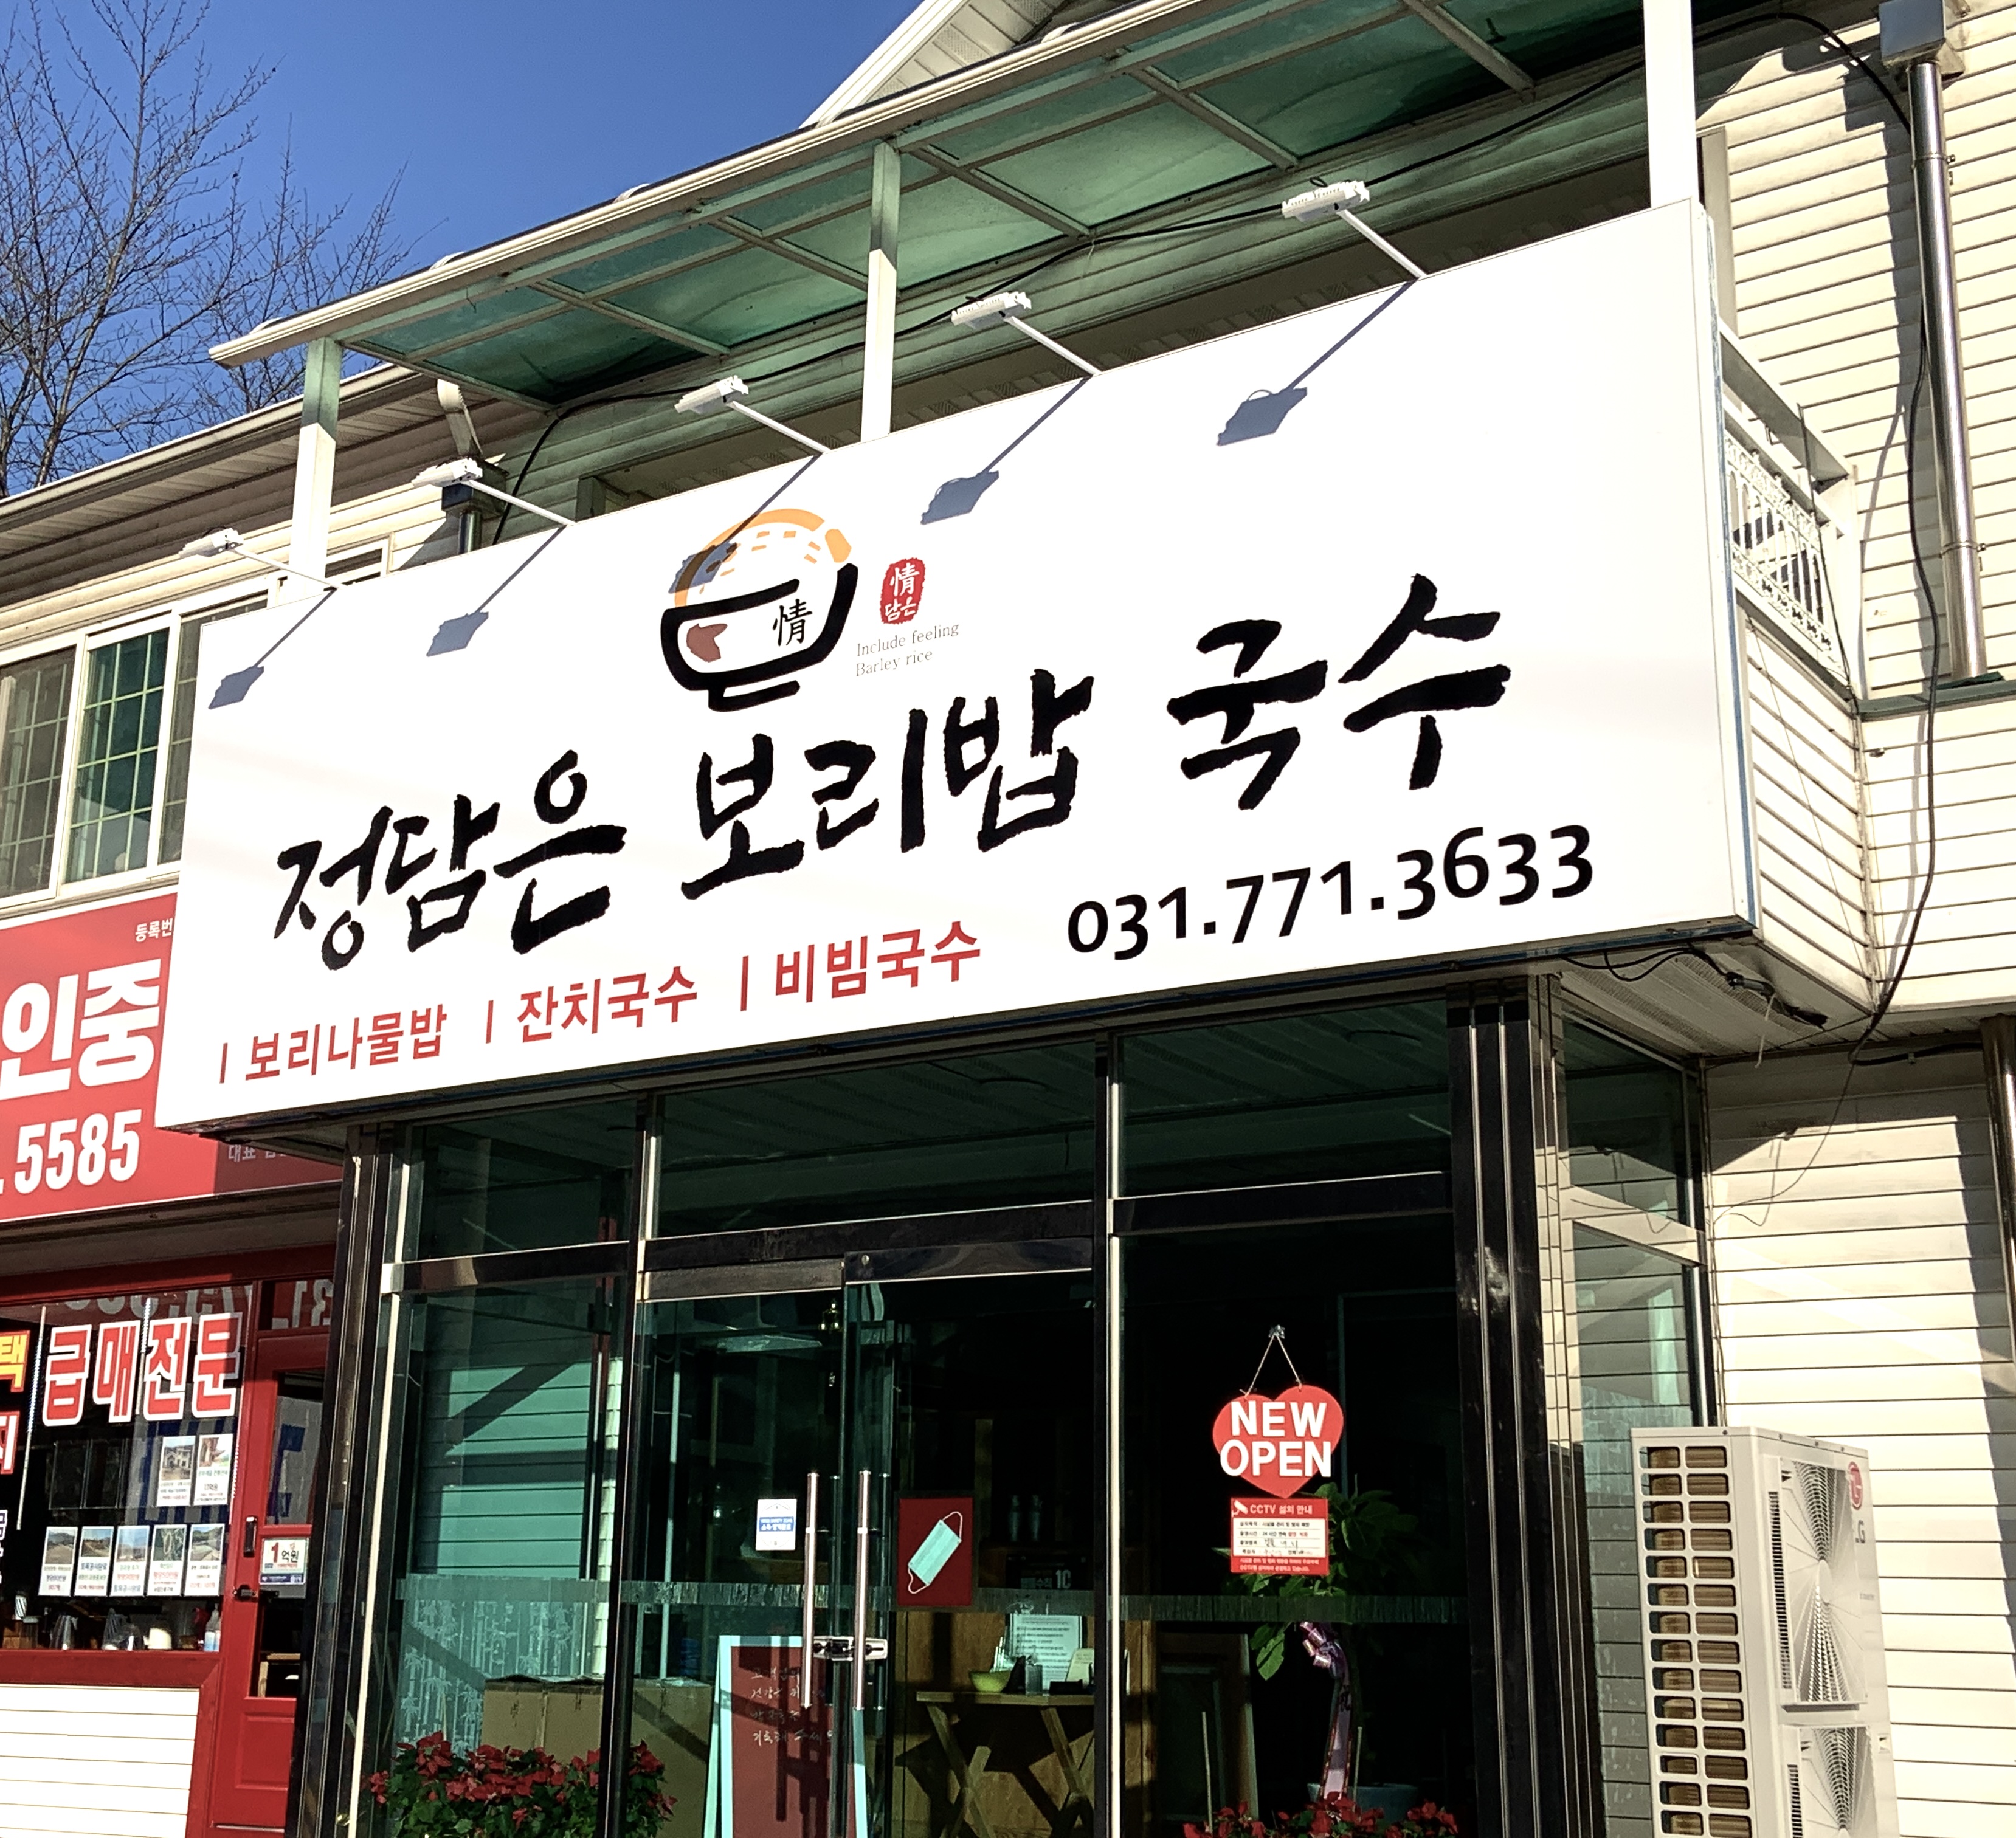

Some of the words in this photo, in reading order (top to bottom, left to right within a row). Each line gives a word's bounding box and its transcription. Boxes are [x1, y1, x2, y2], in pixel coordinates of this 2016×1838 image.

[889, 562, 920, 597] 情
[772, 599, 813, 647] 情
[885, 596, 917, 622] 담은
[857, 635, 906, 656] Include
[912, 624, 959, 644] feeling
[856, 658, 901, 676] Barley
[906, 650, 933, 666] rice
[274, 749, 627, 971] 정담은
[681, 669, 1094, 900] 보리밥
[1166, 573, 1511, 811] 국수
[1068, 825, 1593, 961] 031.771.3633
[246, 1004, 447, 1080] 보리나물밥
[517, 964, 697, 1042] 잔치국수
[775, 921, 981, 1002] 비빔국수
[43, 1312, 243, 1427] 급매전문
[1231, 1400, 1327, 1437] NEW
[1220, 1439, 1332, 1478] OPEN
[1250, 1504, 1276, 1514] CCTV
[1279, 1505, 1294, 1515] 설치
[1297, 1505, 1313, 1515] 안내
